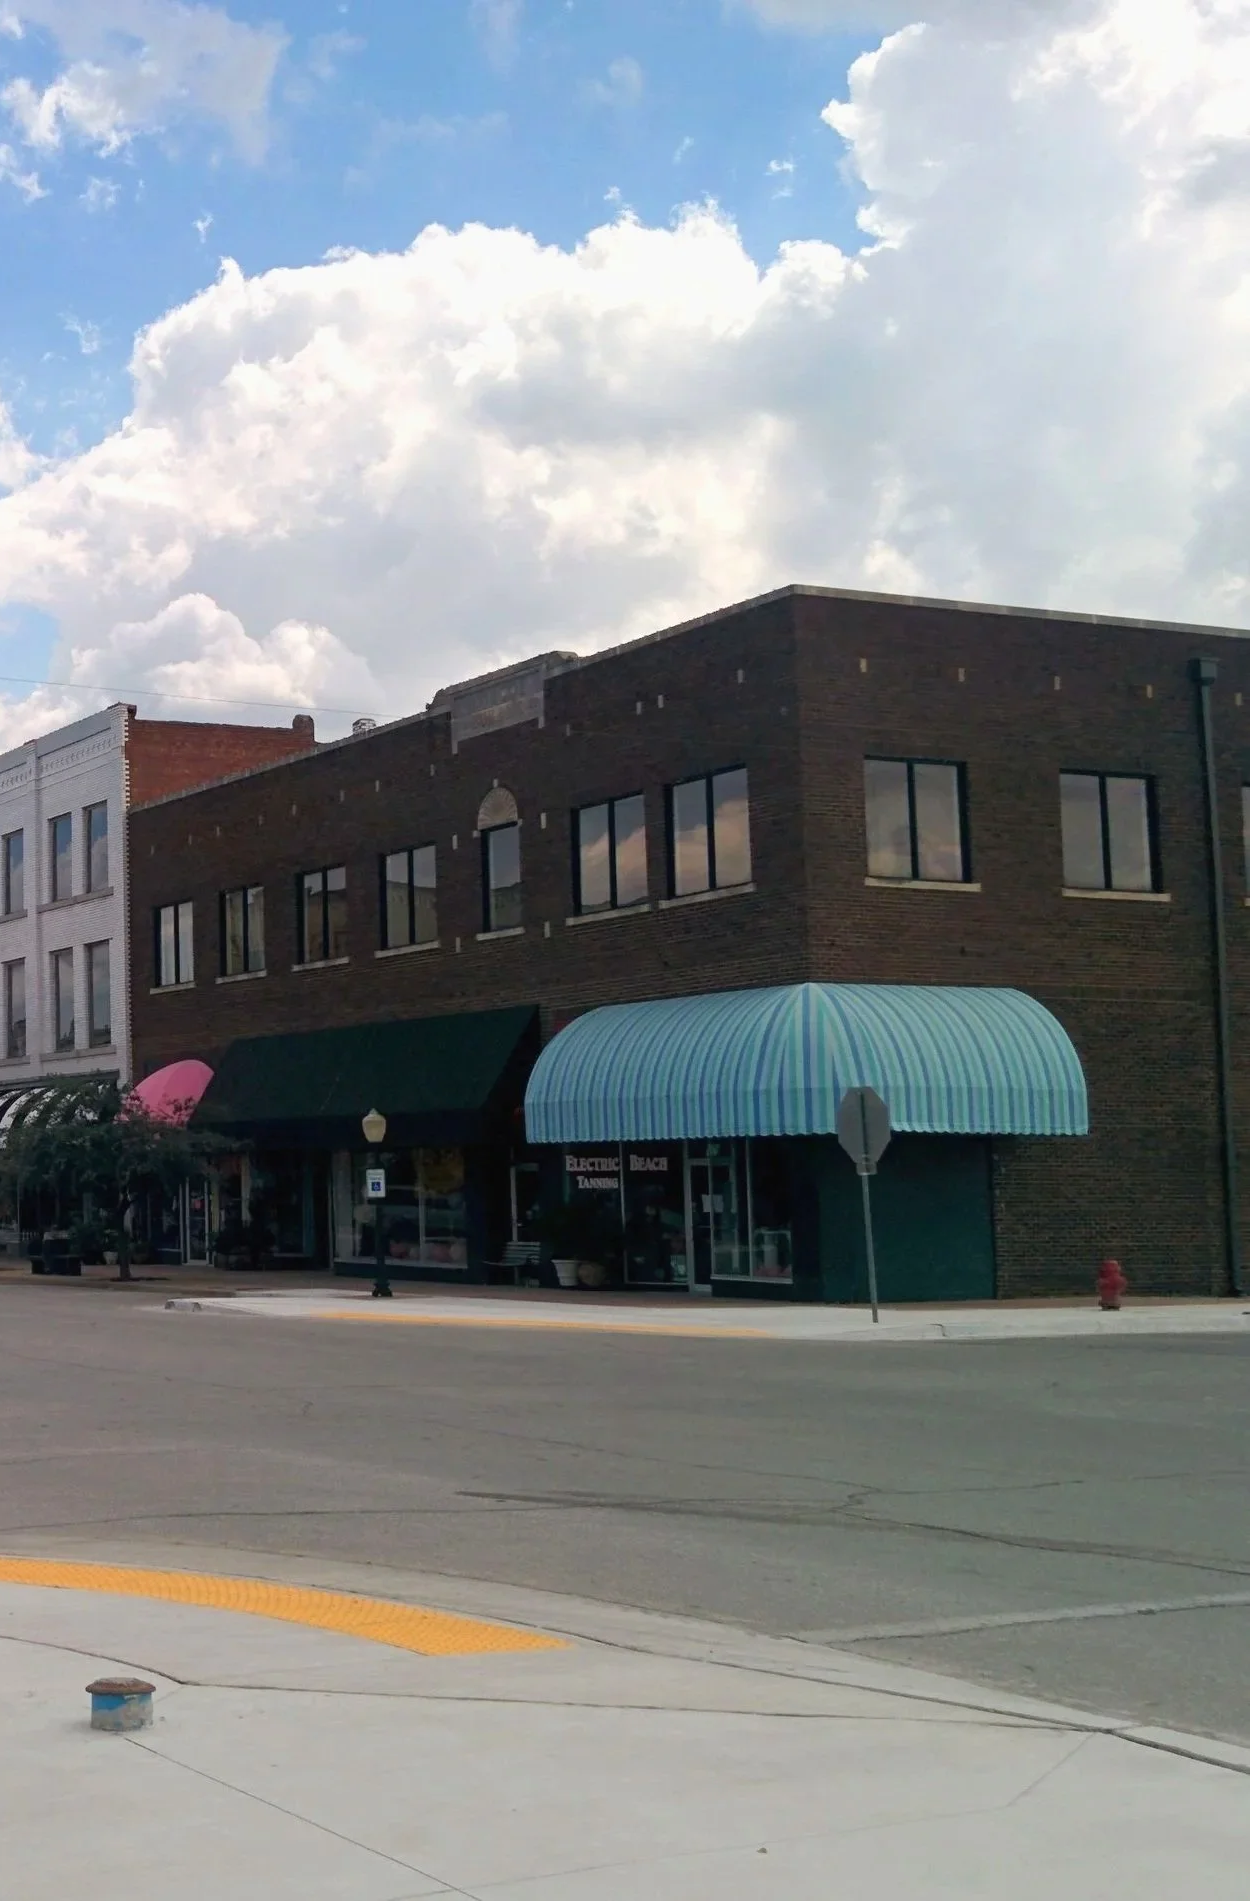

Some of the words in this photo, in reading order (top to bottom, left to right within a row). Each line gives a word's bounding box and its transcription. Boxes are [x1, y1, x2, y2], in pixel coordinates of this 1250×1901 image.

[565, 1155, 621, 1171] ELECTRIC
[629, 1154, 668, 1171] BEACH
[577, 1176, 619, 1189] TANNING
